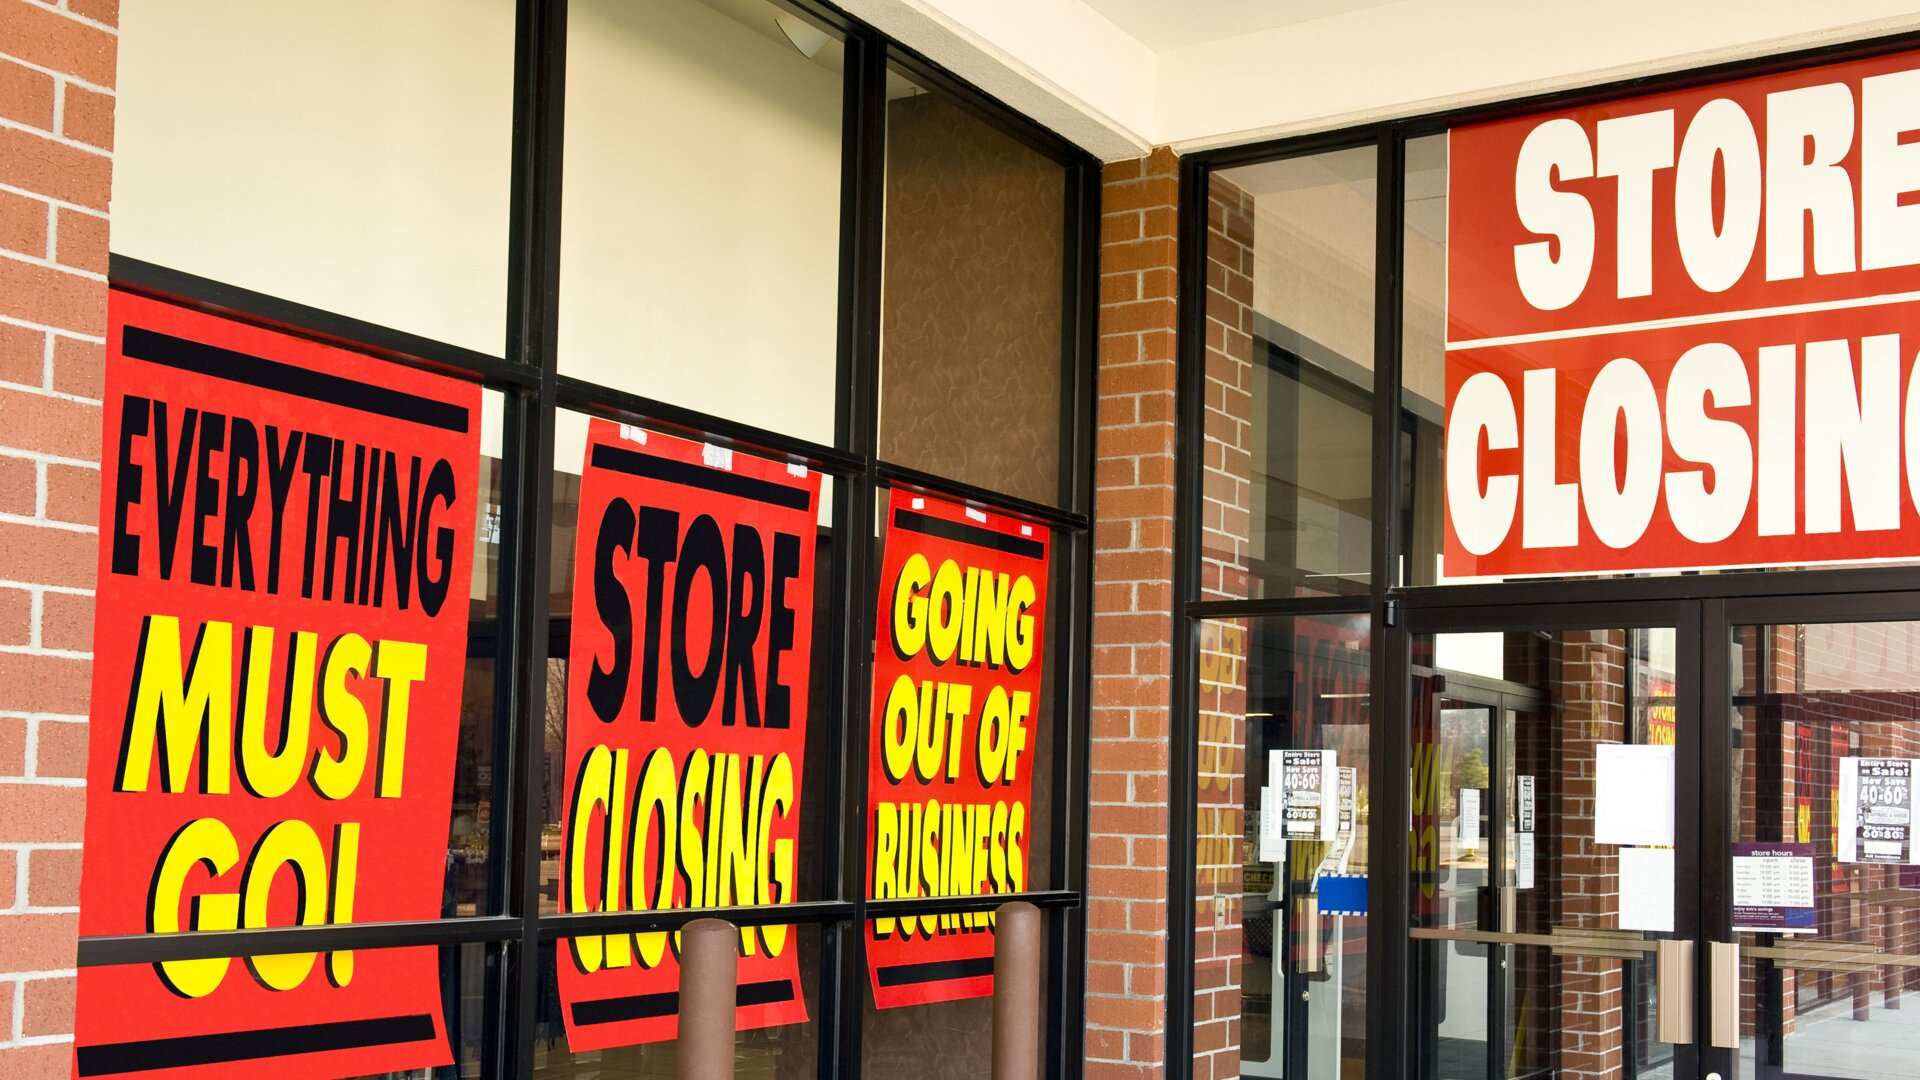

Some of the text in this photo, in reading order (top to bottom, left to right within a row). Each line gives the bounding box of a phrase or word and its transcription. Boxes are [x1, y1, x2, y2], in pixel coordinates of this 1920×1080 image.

[112, 395, 457, 618] EVERYTHING
[1446, 333, 1920, 556] CLOSIN
[587, 497, 800, 729] STORE
[892, 553, 1036, 676] GOING
[114, 615, 428, 800] MUST
[881, 674, 1031, 788] OUT OF
[1872, 767, 1909, 776] Sale!
[1886, 760, 1909, 768] Store
[147, 816, 360, 999] GO!
[564, 744, 794, 976] CLOSING
[873, 799, 1025, 941] BUSINESS
